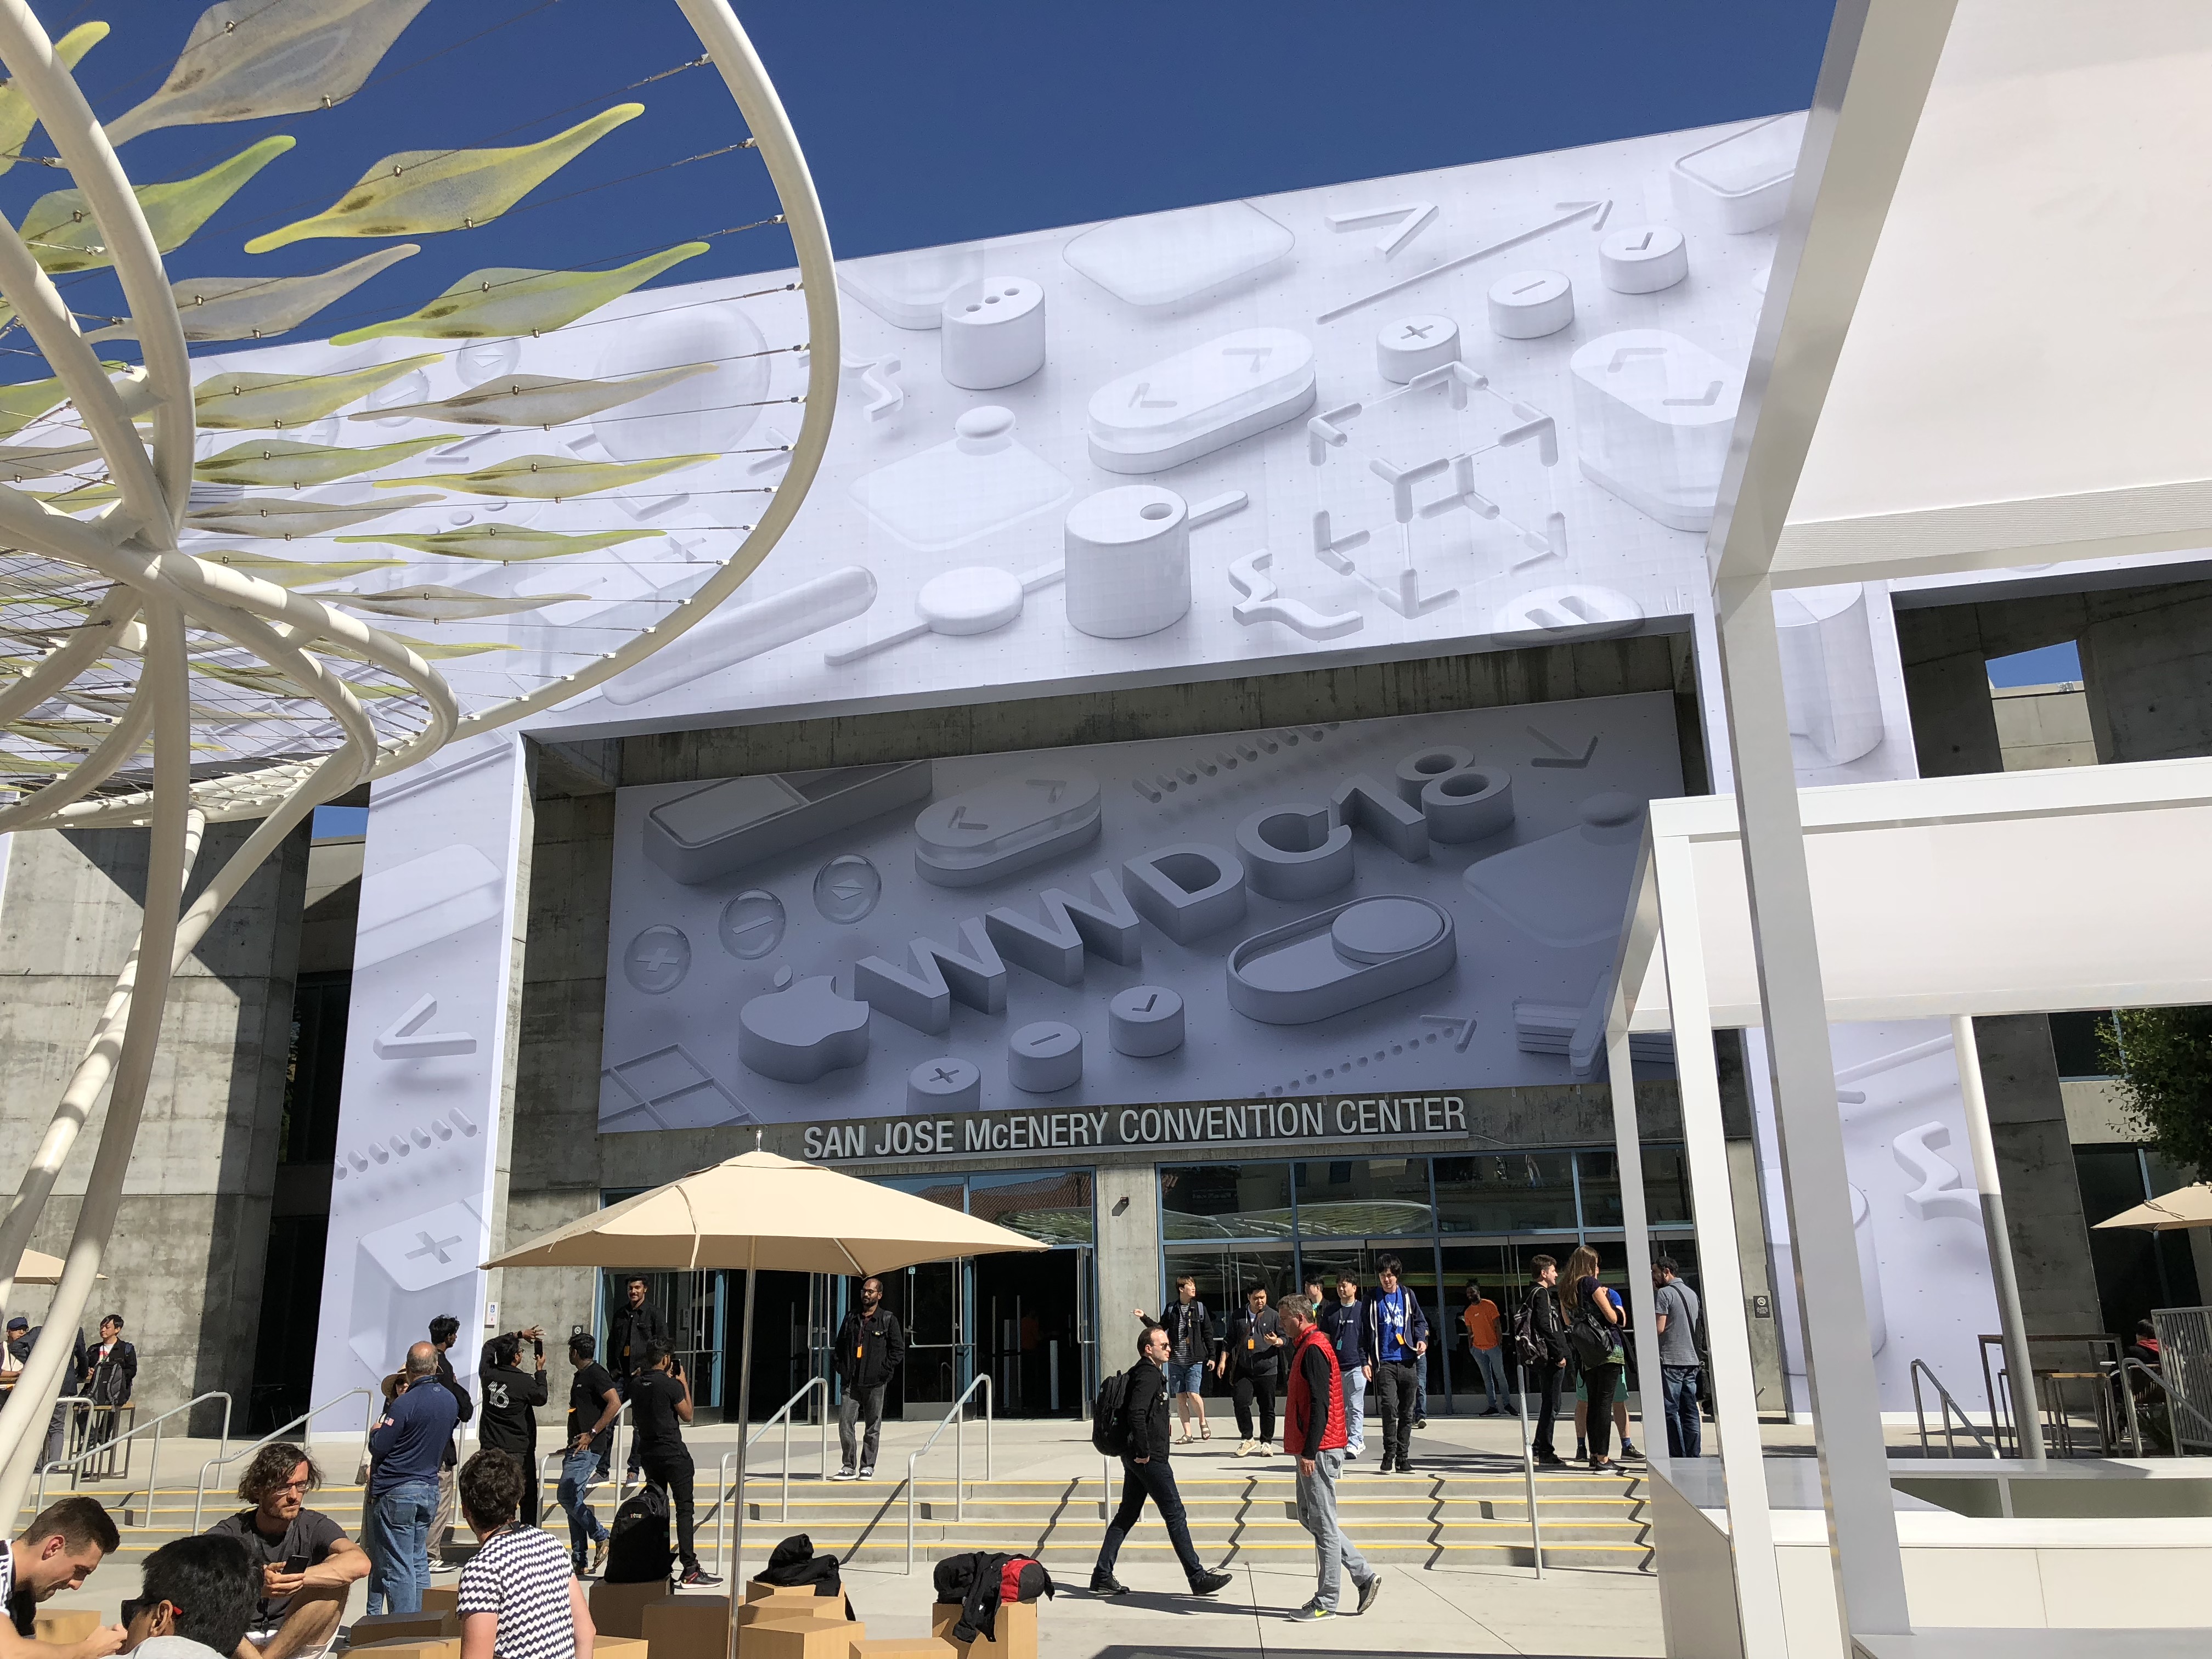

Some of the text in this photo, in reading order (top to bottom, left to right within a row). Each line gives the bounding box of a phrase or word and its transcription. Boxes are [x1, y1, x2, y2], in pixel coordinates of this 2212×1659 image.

[854, 745, 1515, 1036] WWDC18
[803, 1097, 1467, 1159] SAN JOSE McENERY CONVENTION CENTER
